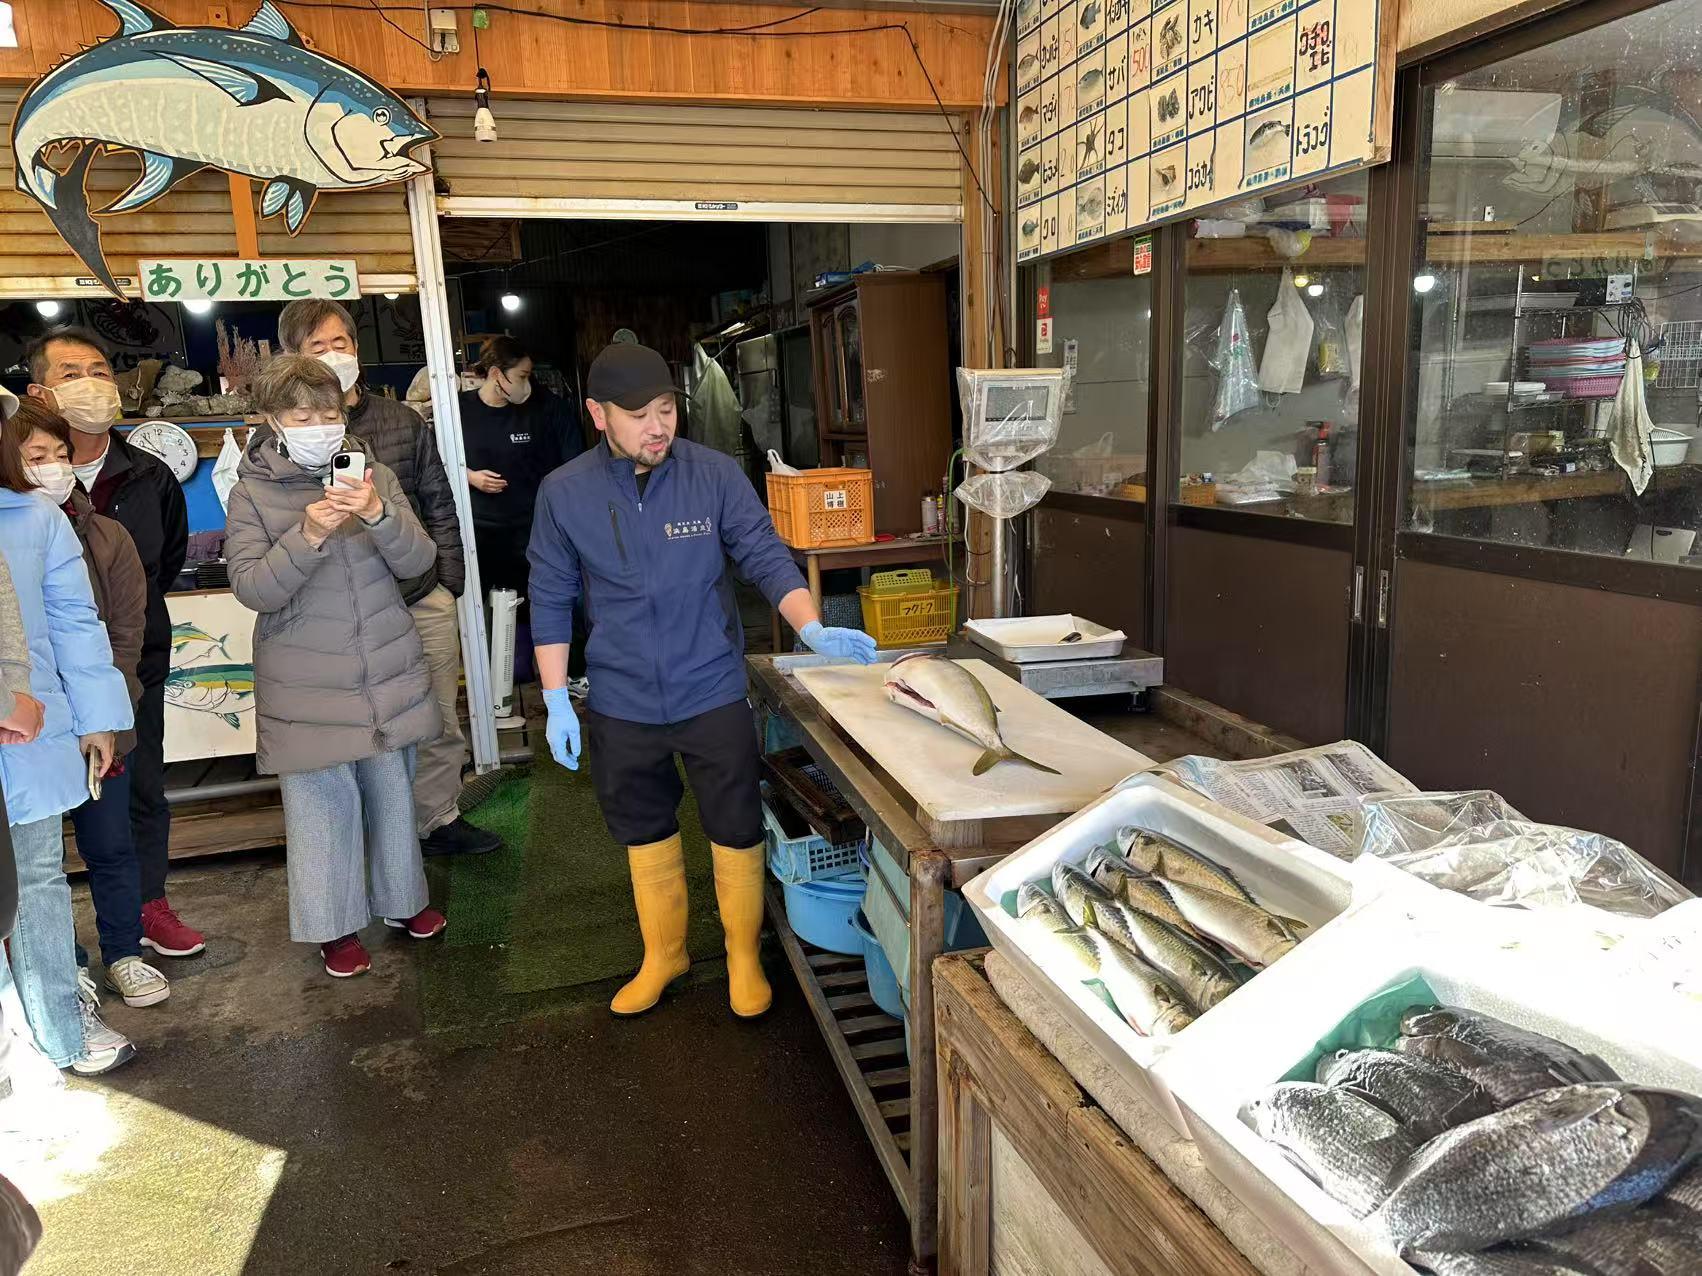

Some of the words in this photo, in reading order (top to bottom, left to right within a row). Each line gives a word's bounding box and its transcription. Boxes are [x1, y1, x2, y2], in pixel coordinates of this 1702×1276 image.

[1193, 9, 1214, 44] カキ
[1107, 54, 1127, 92] サバ
[1042, 93, 1058, 125] マダイ
[1189, 74, 1215, 120] アワビ
[1107, 127, 1125, 156] タコ
[1295, 105, 1330, 158] トラフグ
[1042, 157, 1058, 185] ヒラメ
[1043, 215, 1056, 241] クロ
[147, 262, 350, 298] ありがとう
[177, 438, 184, 446] 2
[183, 449, 189, 457] 3
[173, 467, 180, 476] 5
[826, 491, 844, 500] 山上
